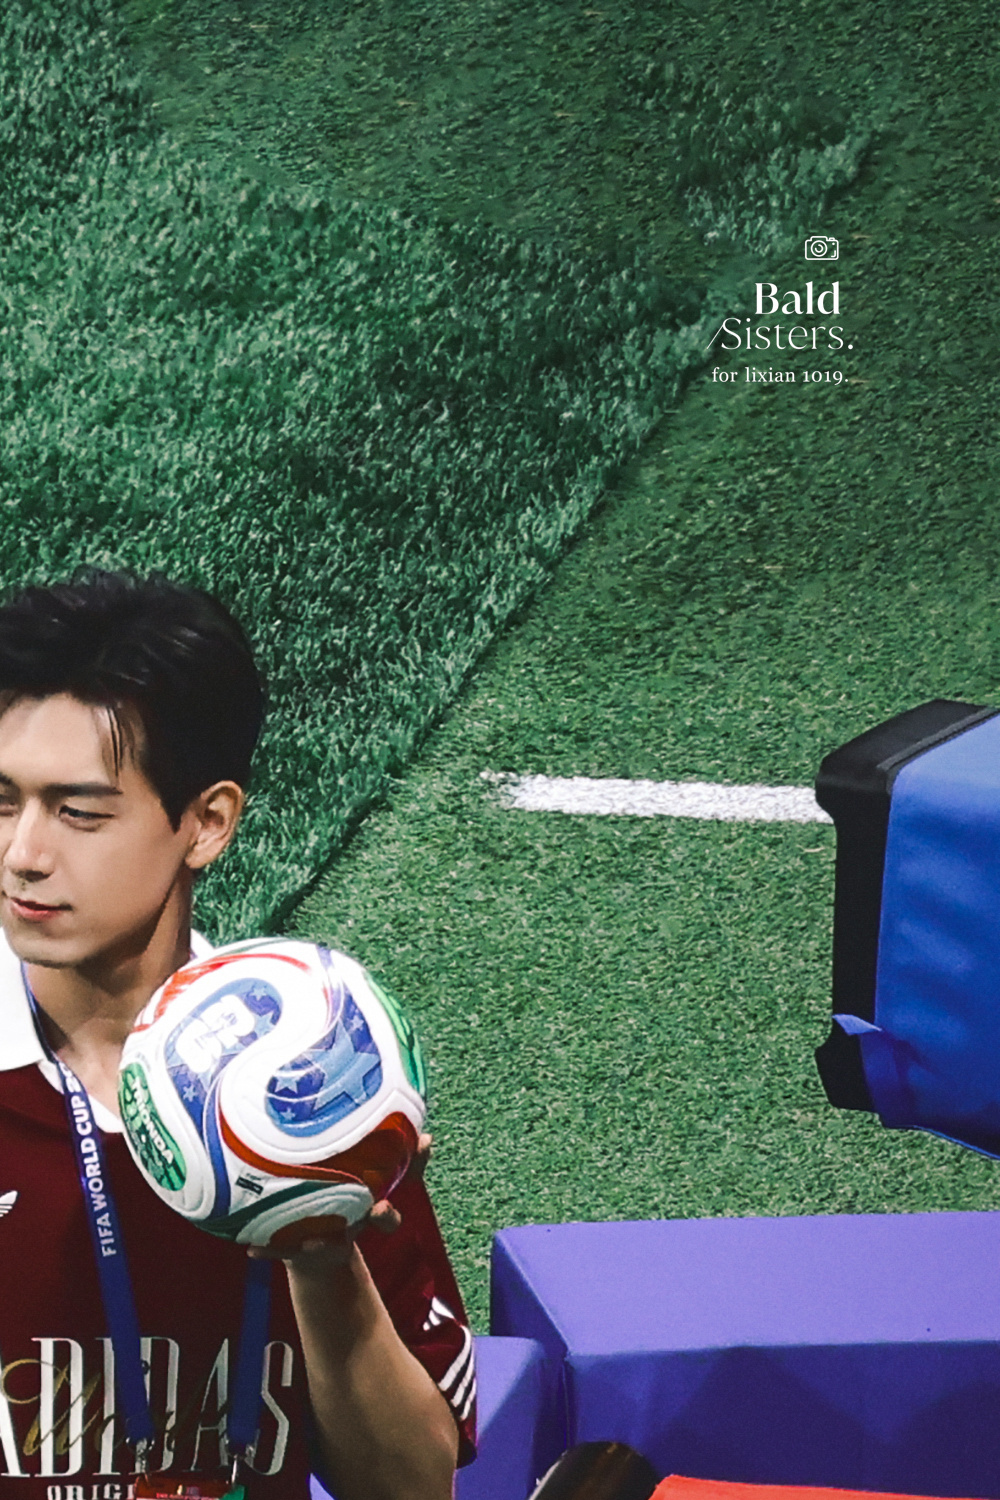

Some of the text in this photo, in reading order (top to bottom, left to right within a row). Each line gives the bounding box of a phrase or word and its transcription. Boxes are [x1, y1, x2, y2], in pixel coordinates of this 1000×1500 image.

[71, 1095, 93, 1136] CUP
[81, 1137, 109, 1212] WORLD
[96, 1212, 117, 1257] FIFA
